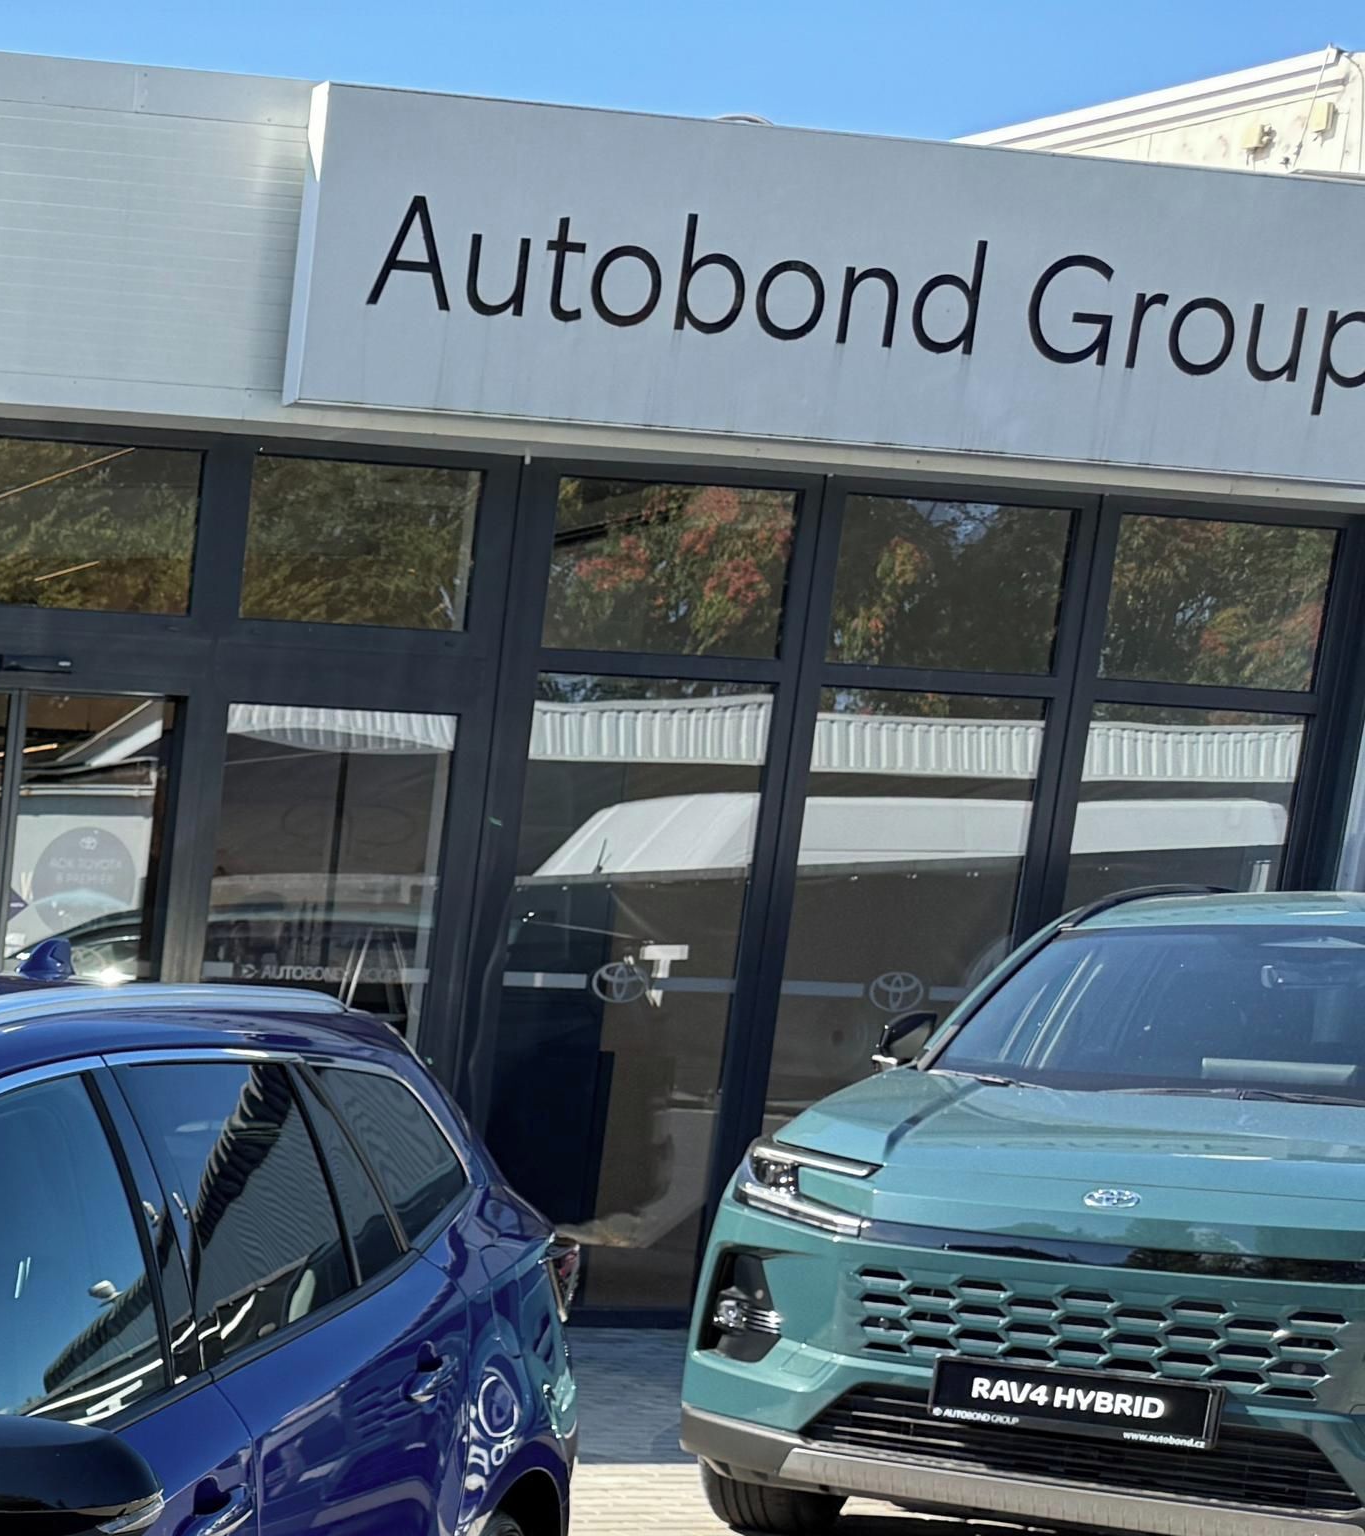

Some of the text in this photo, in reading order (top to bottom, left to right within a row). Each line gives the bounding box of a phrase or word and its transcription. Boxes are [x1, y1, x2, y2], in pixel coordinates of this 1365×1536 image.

[366, 195, 1365, 416] Autobond Group
[971, 1377, 1166, 1419] RAV4 HYBRID
[943, 1408, 1020, 1426] AUTOBOND GROUP
[1122, 1431, 1206, 1449] www.autobond.cz
